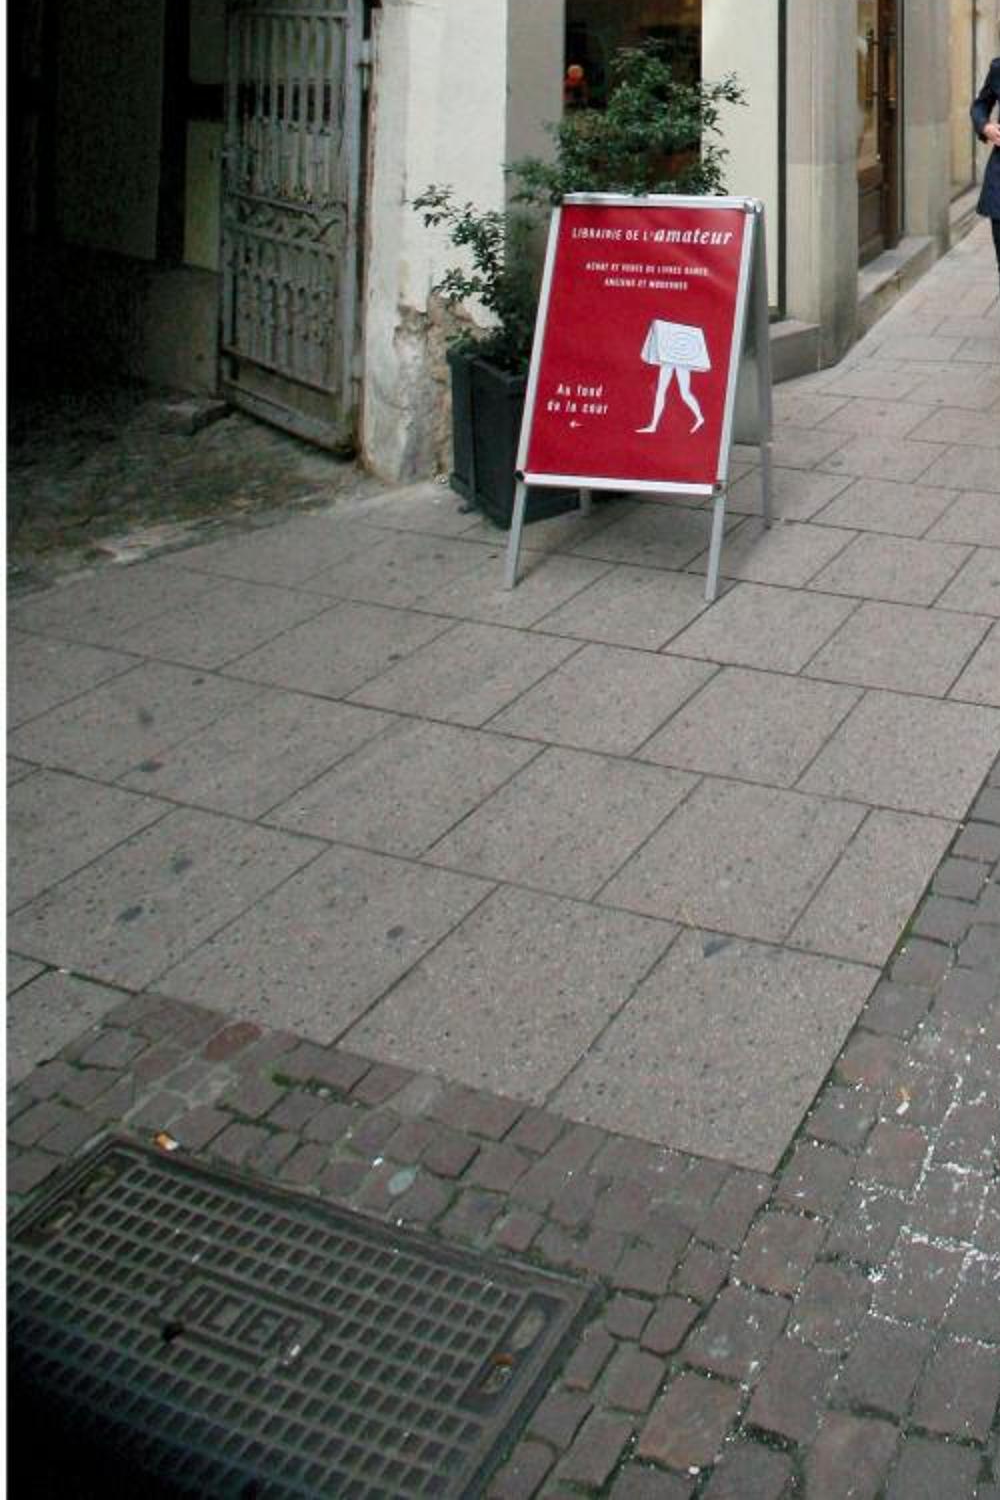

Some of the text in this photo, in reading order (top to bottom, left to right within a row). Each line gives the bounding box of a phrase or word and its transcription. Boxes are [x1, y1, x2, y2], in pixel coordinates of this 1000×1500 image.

[571, 227, 621, 241] LIBRAIRIE
[625, 229, 639, 241] DE
[577, 384, 603, 398] fond
[582, 403, 608, 414] cour
